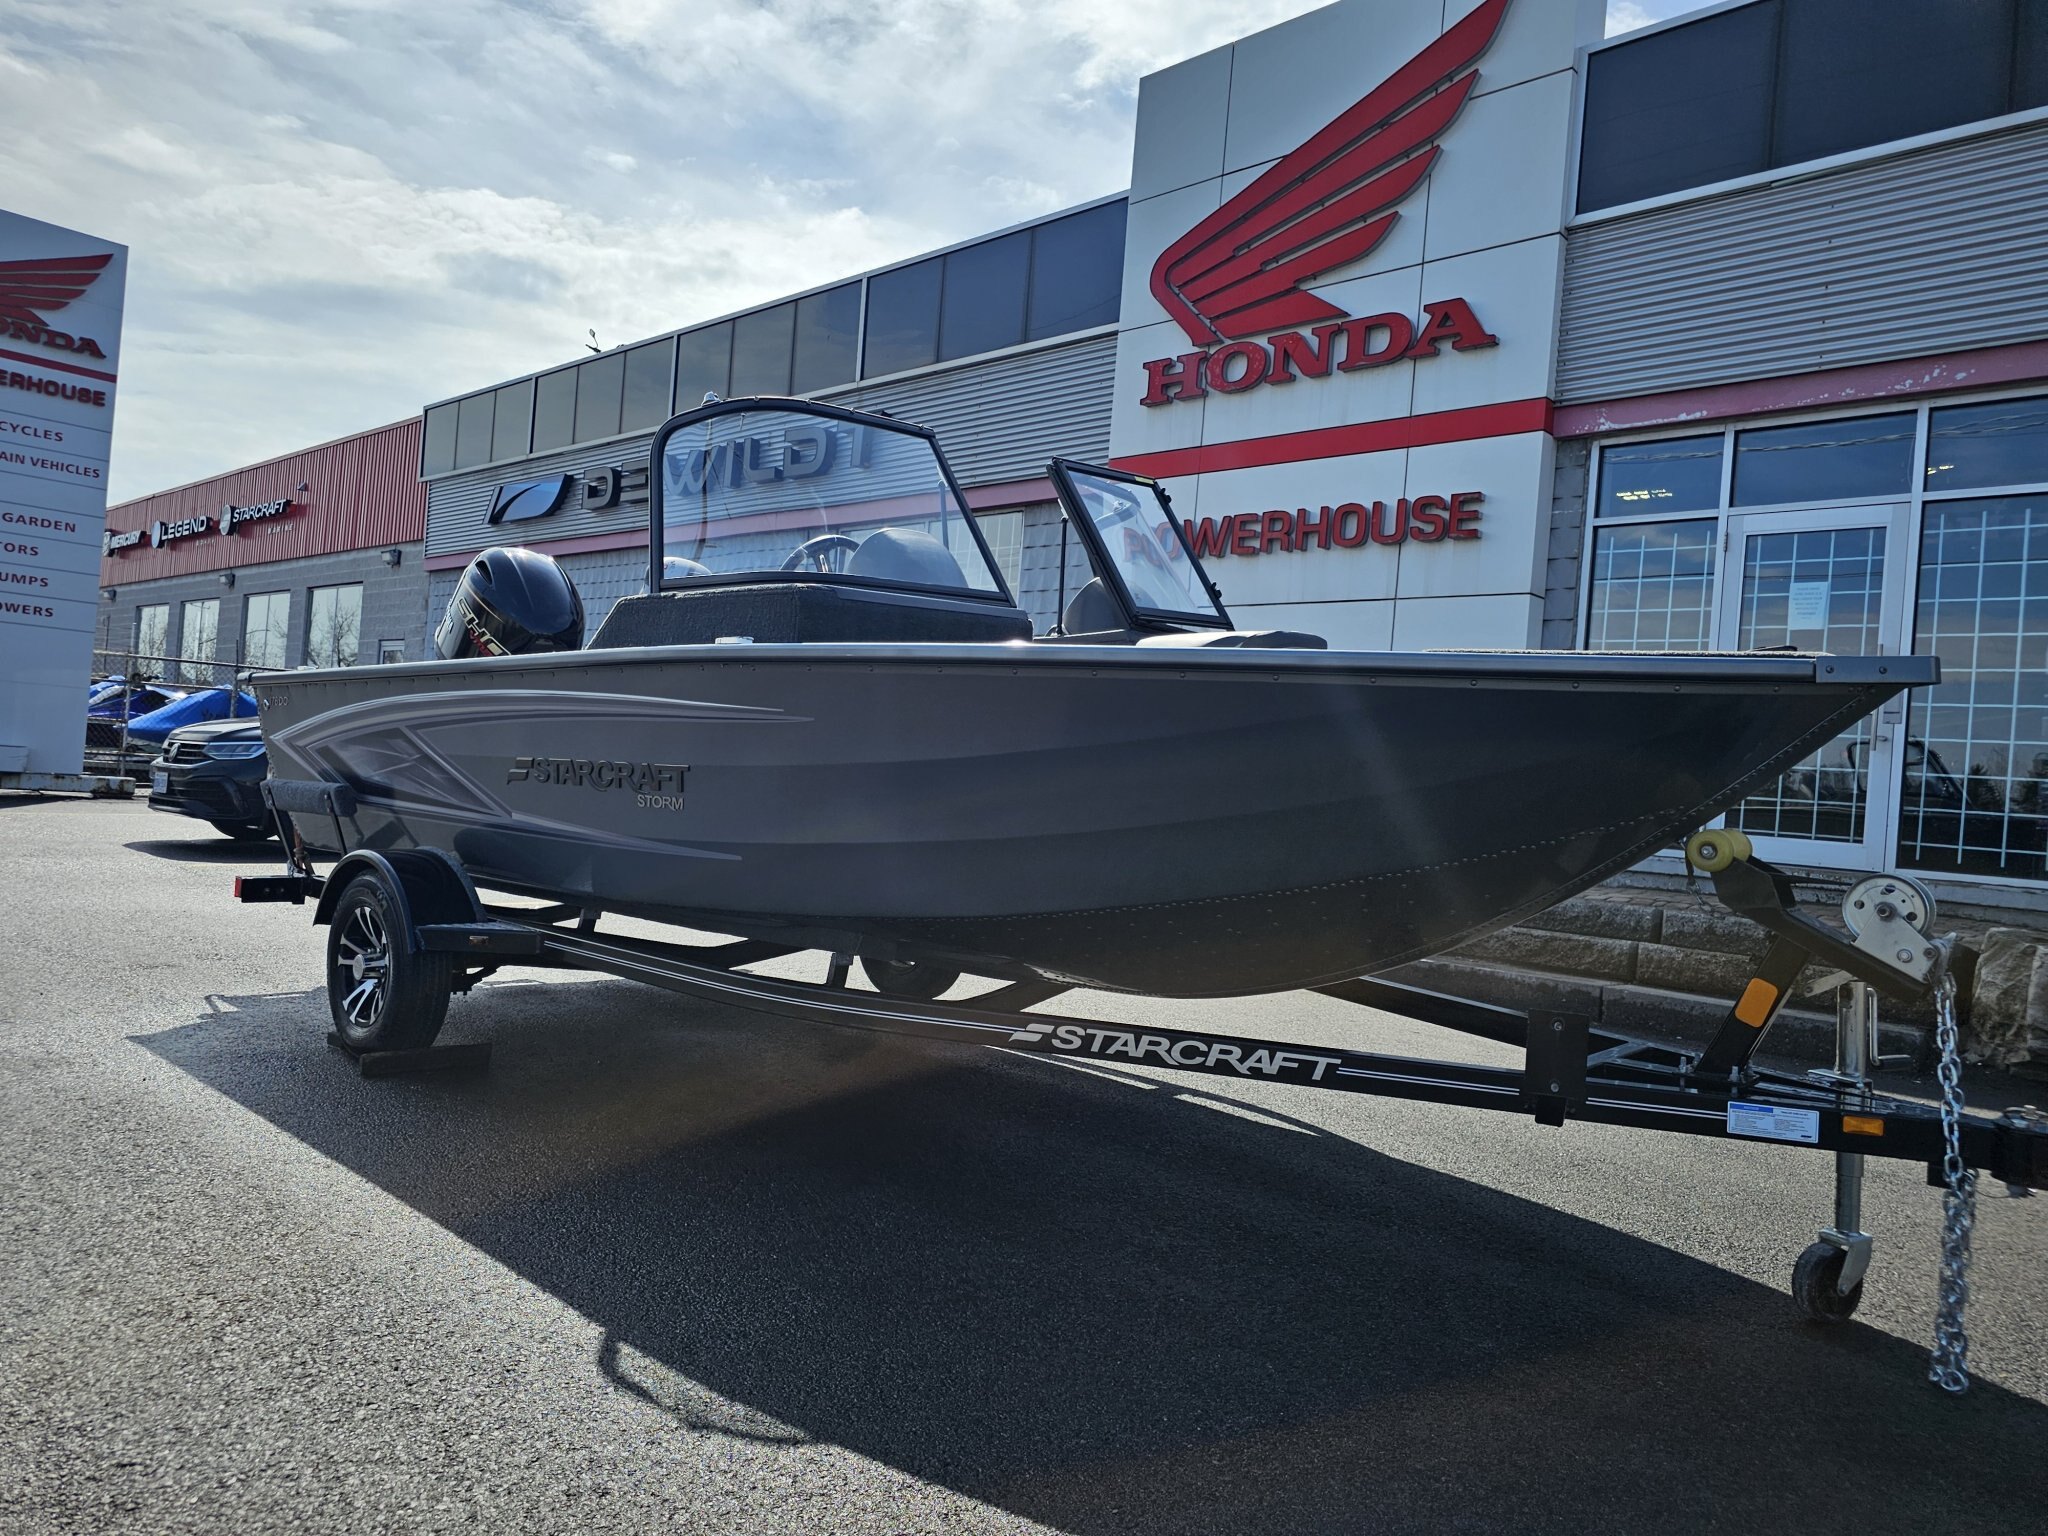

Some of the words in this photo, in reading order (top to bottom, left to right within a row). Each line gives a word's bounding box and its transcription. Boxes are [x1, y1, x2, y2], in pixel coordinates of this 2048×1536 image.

[1140, 298, 1499, 407] HONDA
[0, 421, 63, 442] CYCLES
[0, 451, 26, 465] AIN
[30, 456, 100, 479] VEHICLES
[2, 512, 76, 533] GARDEN
[232, 499, 287, 523] STARCRAFT
[162, 515, 207, 540] LEGEND
[1124, 492, 1485, 562] POWERHOUSE
[110, 531, 141, 549] MERCURY
[0, 602, 54, 618] WERS
[534, 757, 691, 793] STARCRAFT
[637, 794, 685, 811] STORM
[1051, 1025, 1342, 1081] STARCRAFT
